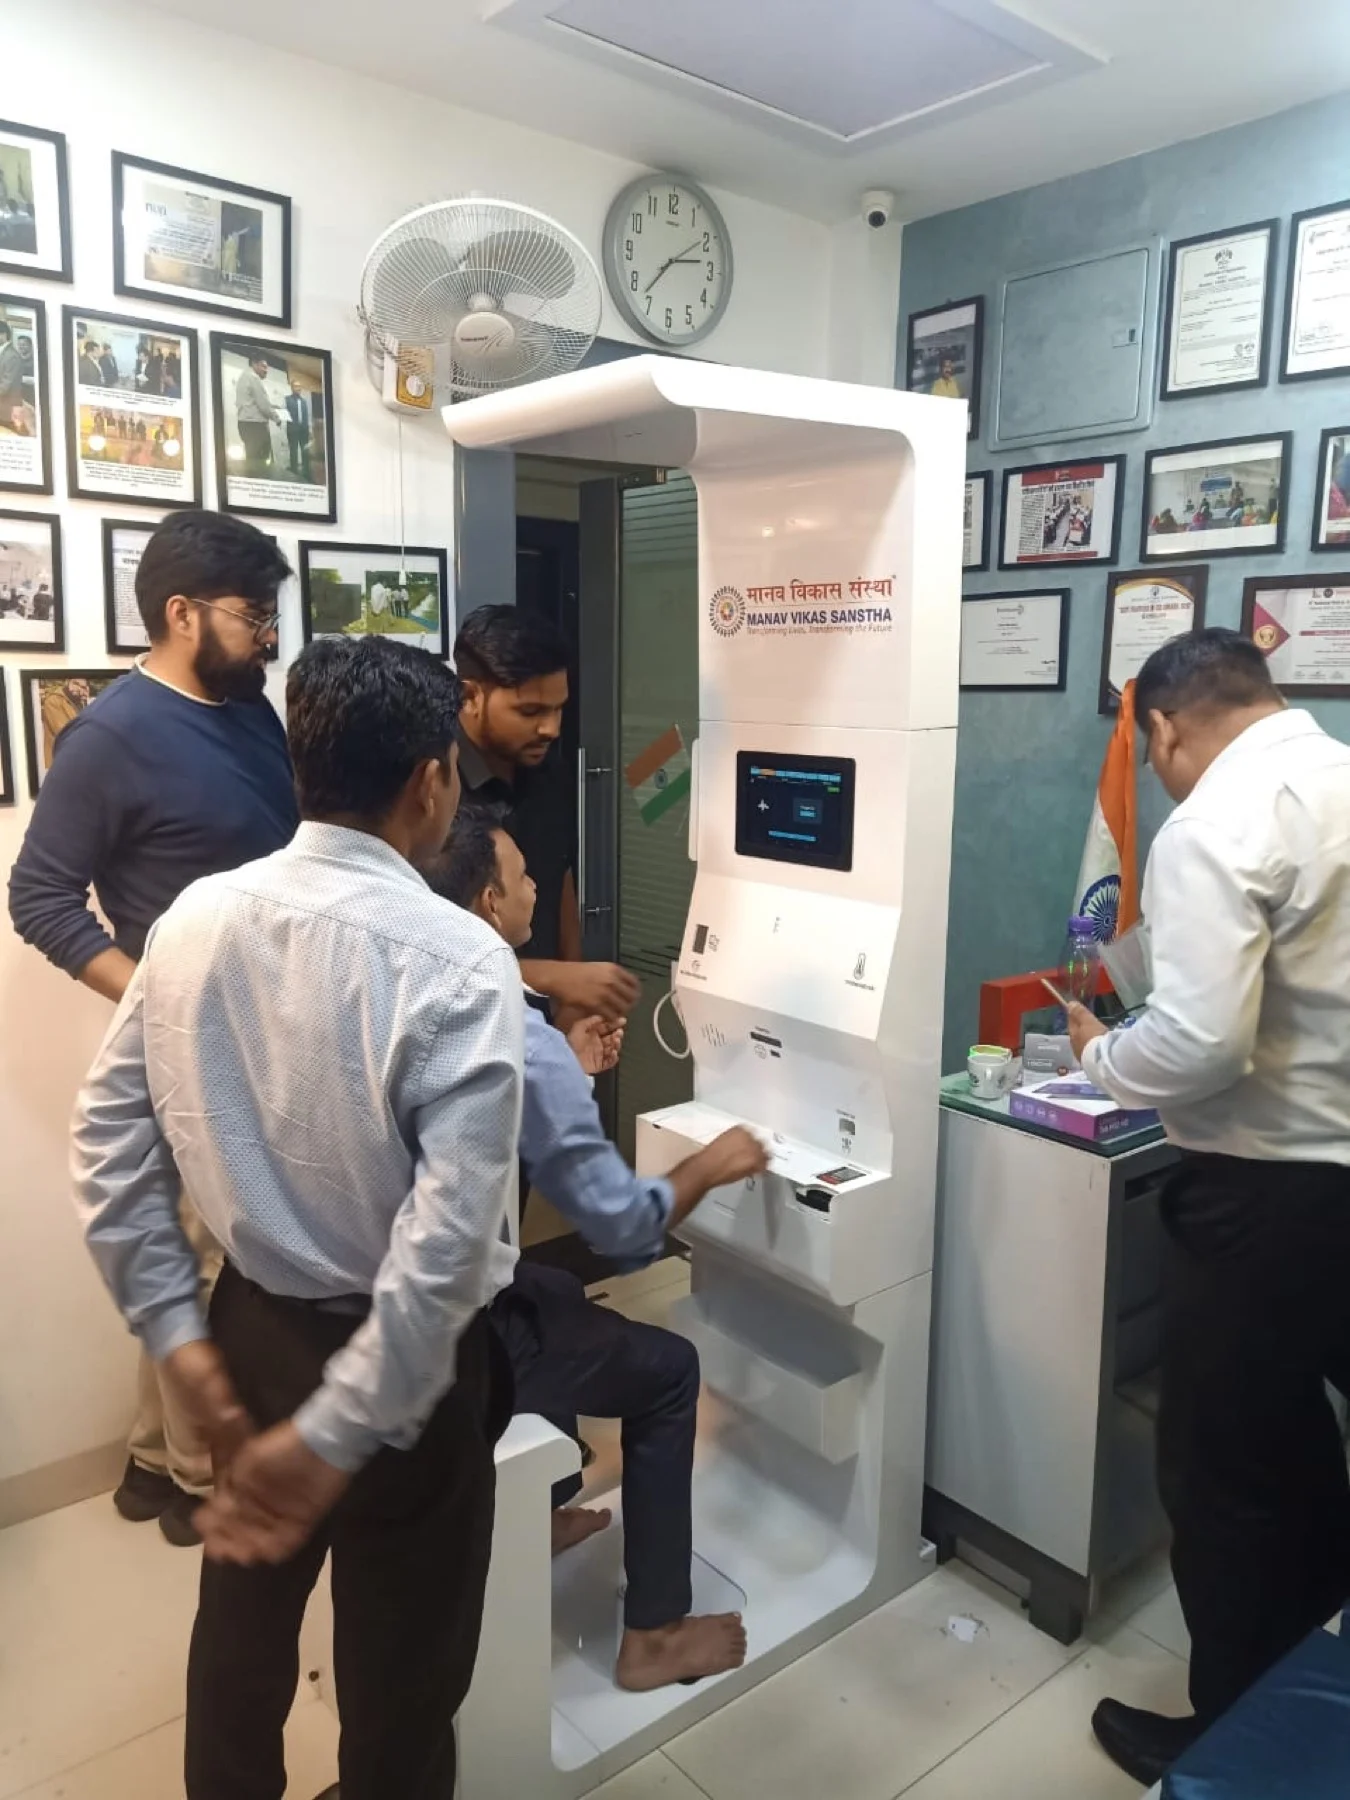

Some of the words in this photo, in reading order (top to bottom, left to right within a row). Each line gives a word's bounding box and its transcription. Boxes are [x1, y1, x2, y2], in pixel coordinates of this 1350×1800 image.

[647, 195, 657, 218] 11
[668, 193, 679, 215] 12
[632, 213, 642, 234] 10
[691, 207, 696, 228] 1
[625, 240, 633, 260] 9
[702, 232, 710, 252] 2
[630, 271, 638, 291] 8
[706, 261, 714, 281] 3
[645, 295, 652, 315] 7
[700, 288, 707, 308] 4
[664, 308, 672, 328] 6
[685, 305, 692, 325] 5
[746, 585, 785, 603] मानव
[790, 578, 842, 602] विकास
[848, 576, 893, 599] संस्था
[747, 612, 788, 626] MANAV
[791, 610, 827, 624] VIKAS
[830, 608, 892, 624] SANSTHA
